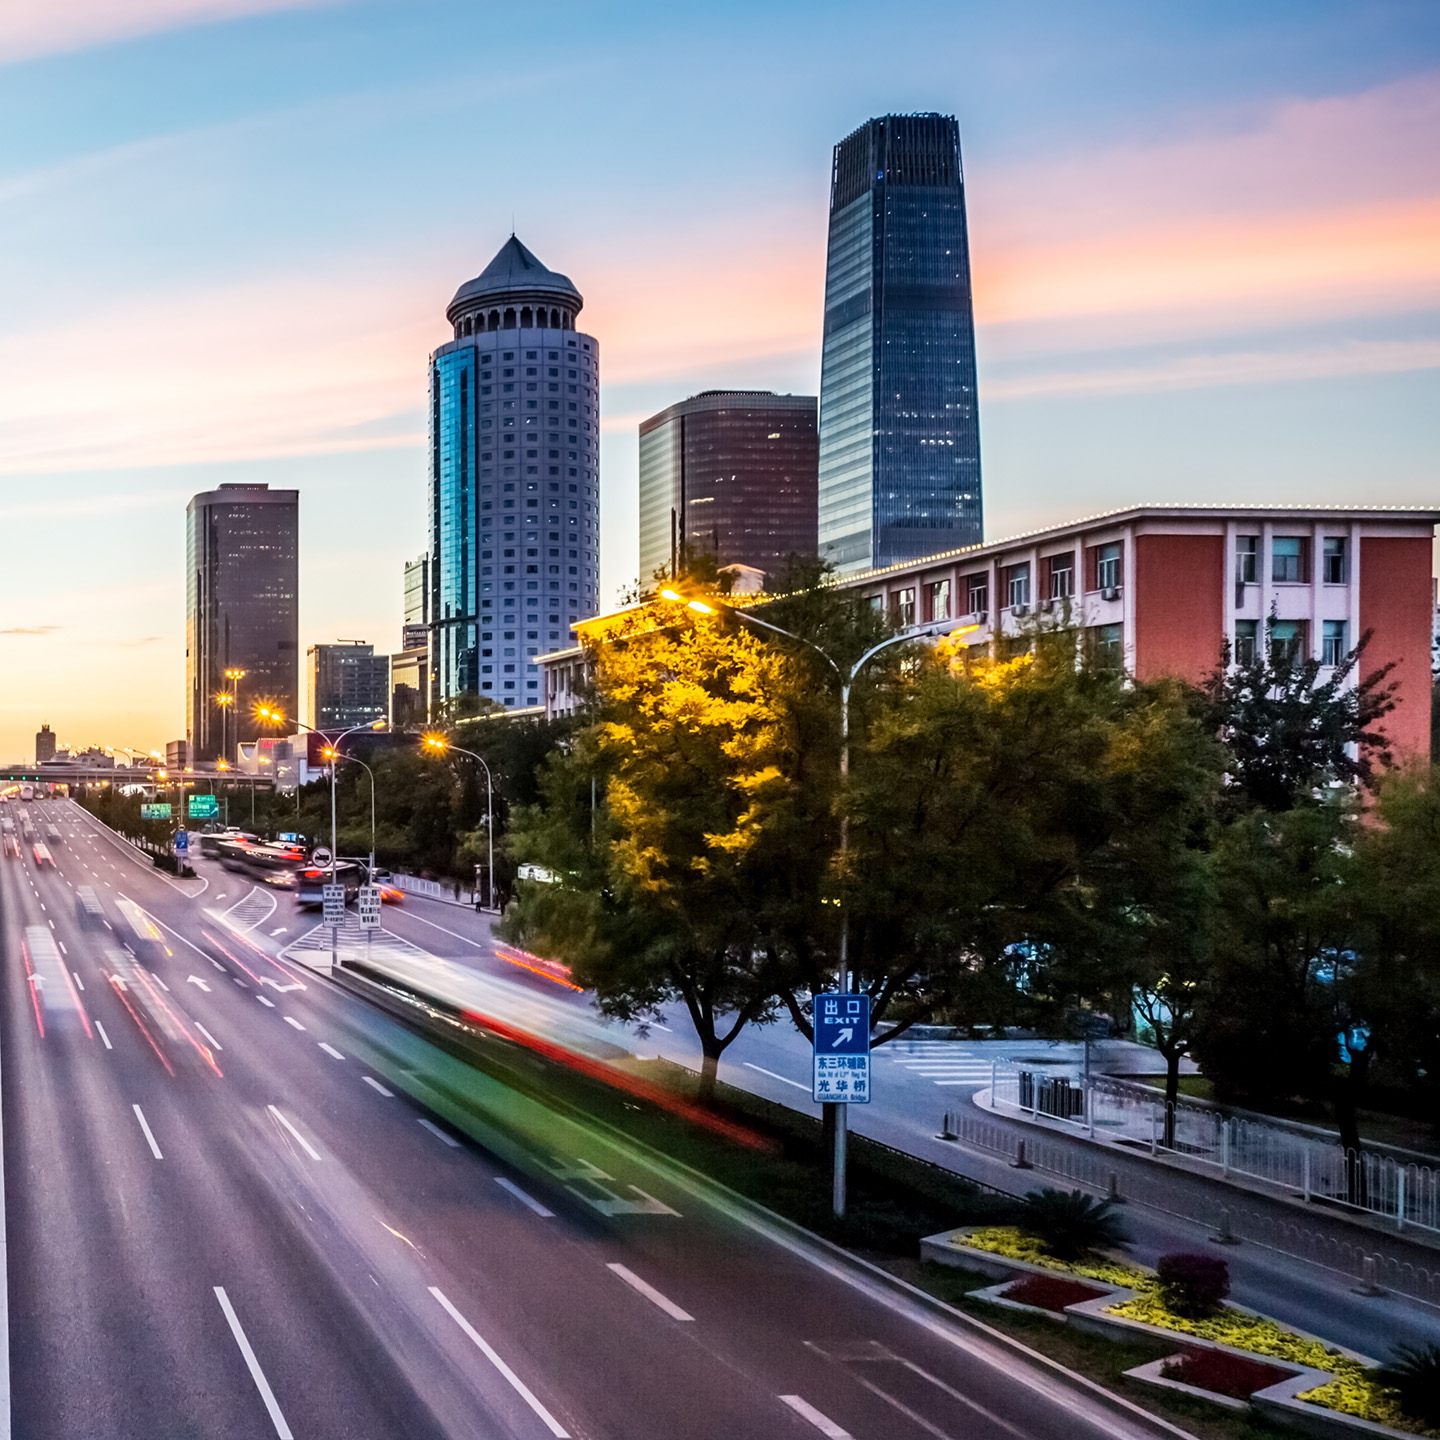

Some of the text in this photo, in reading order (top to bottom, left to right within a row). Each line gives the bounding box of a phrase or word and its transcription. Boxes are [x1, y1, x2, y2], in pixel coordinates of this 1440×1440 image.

[824, 1000, 860, 1015] 出口
[818, 1057, 866, 1070] 东三环辅路
[818, 1080, 866, 1092] 光华桥
